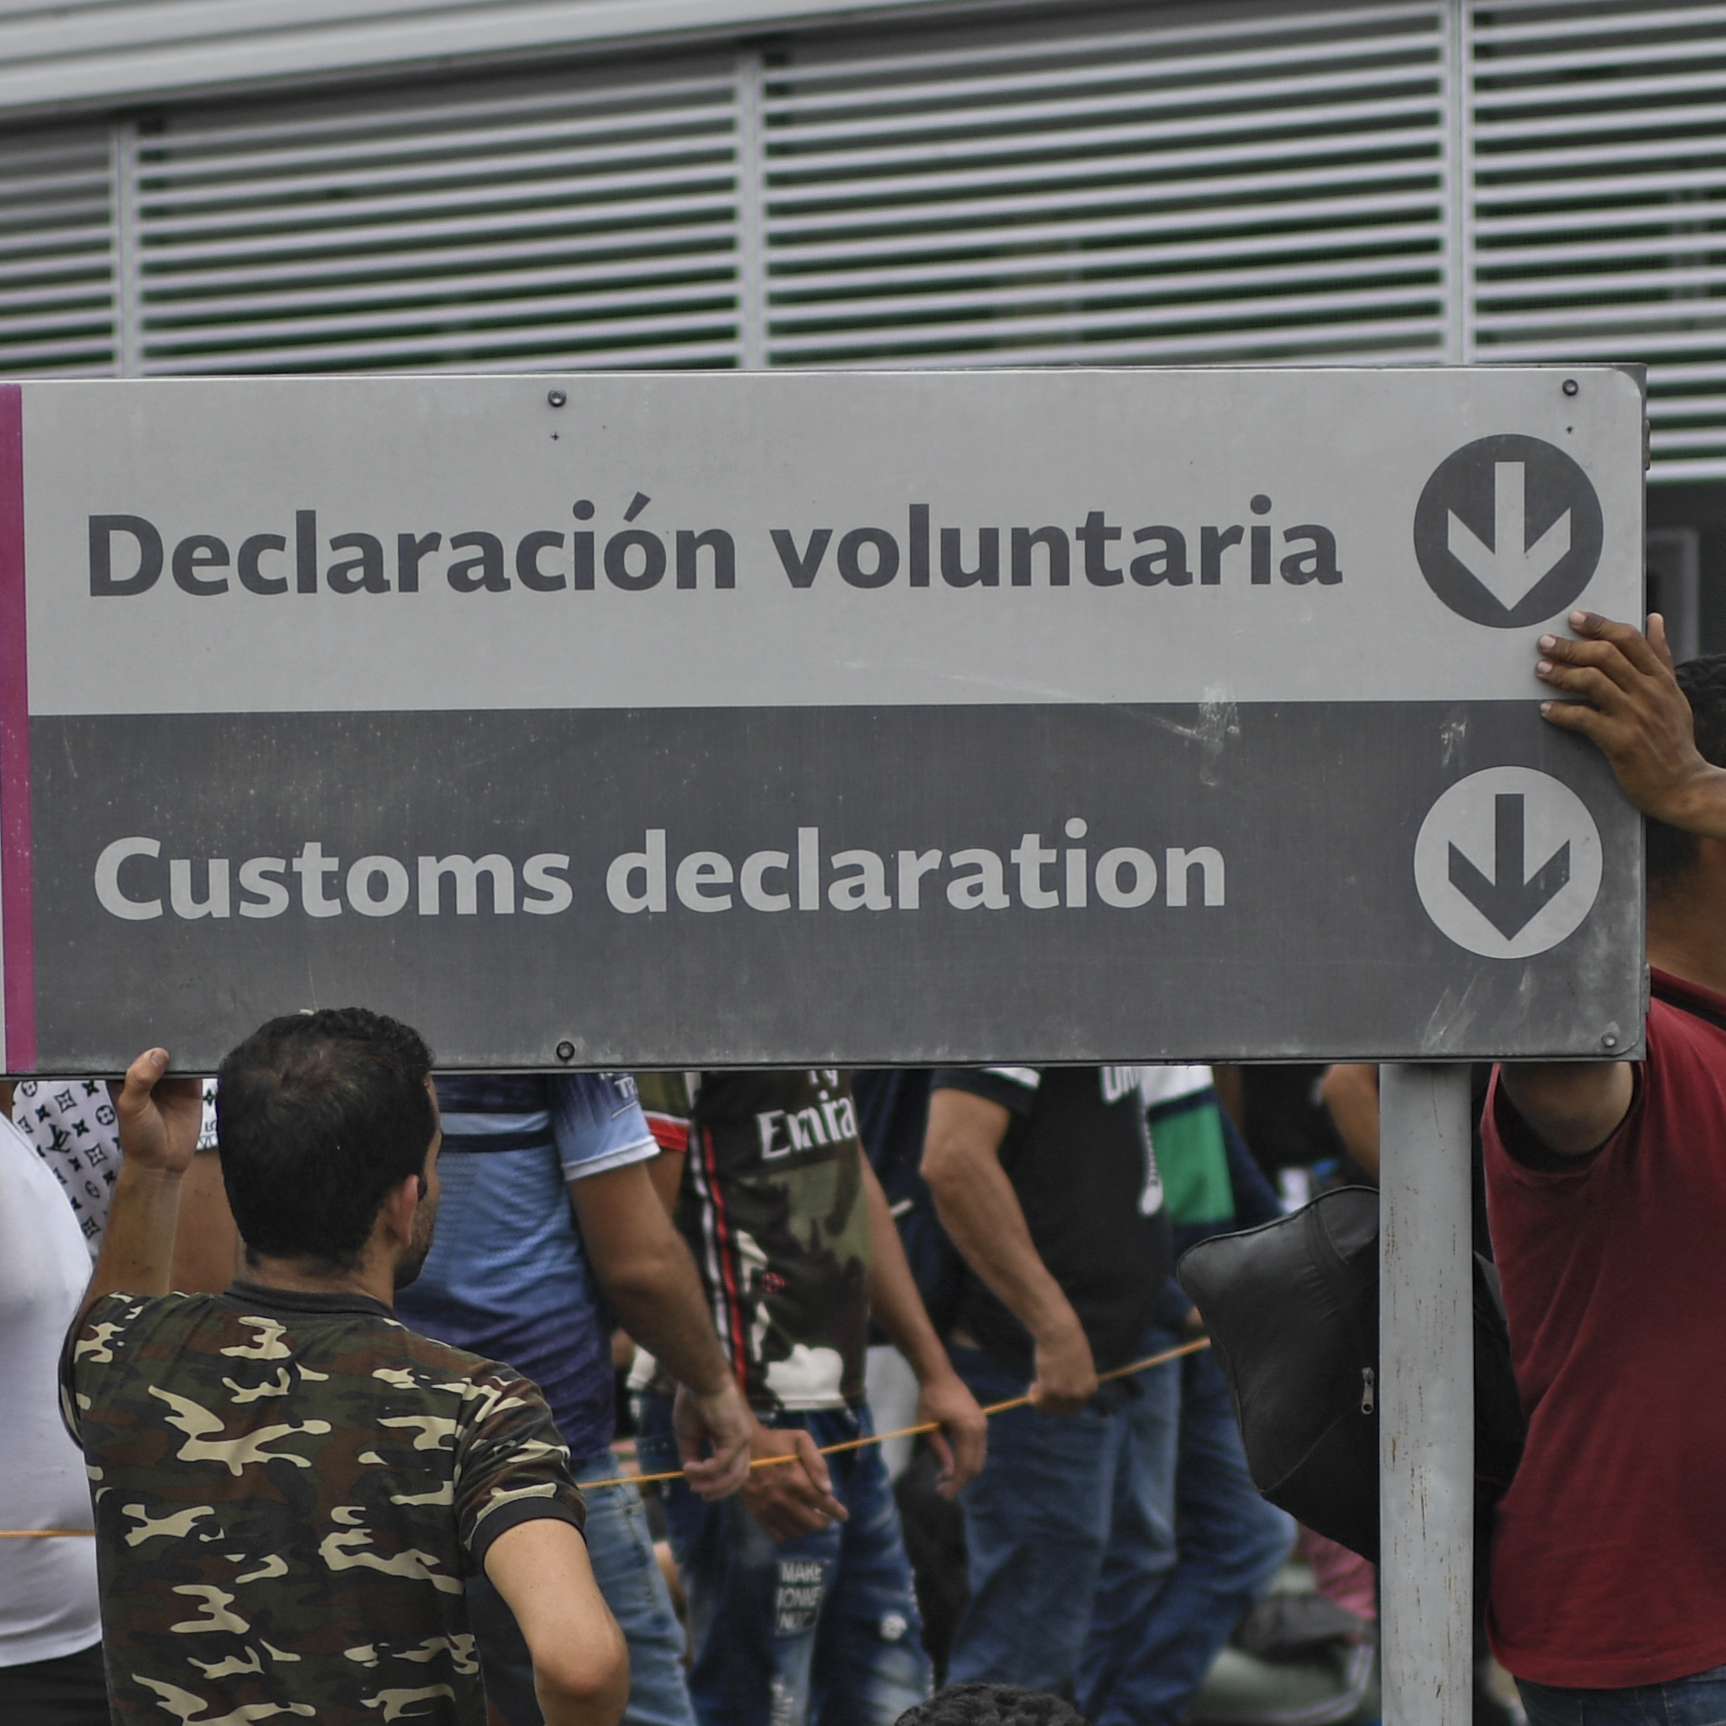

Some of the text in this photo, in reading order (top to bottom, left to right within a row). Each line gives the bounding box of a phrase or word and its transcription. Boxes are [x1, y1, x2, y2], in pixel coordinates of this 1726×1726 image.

[88, 491, 1344, 597] Declaración voluntaria
[93, 817, 1225, 921] Customs declaration
[756, 1090, 858, 1160] Emira
[781, 1561, 822, 1583] MAKE
